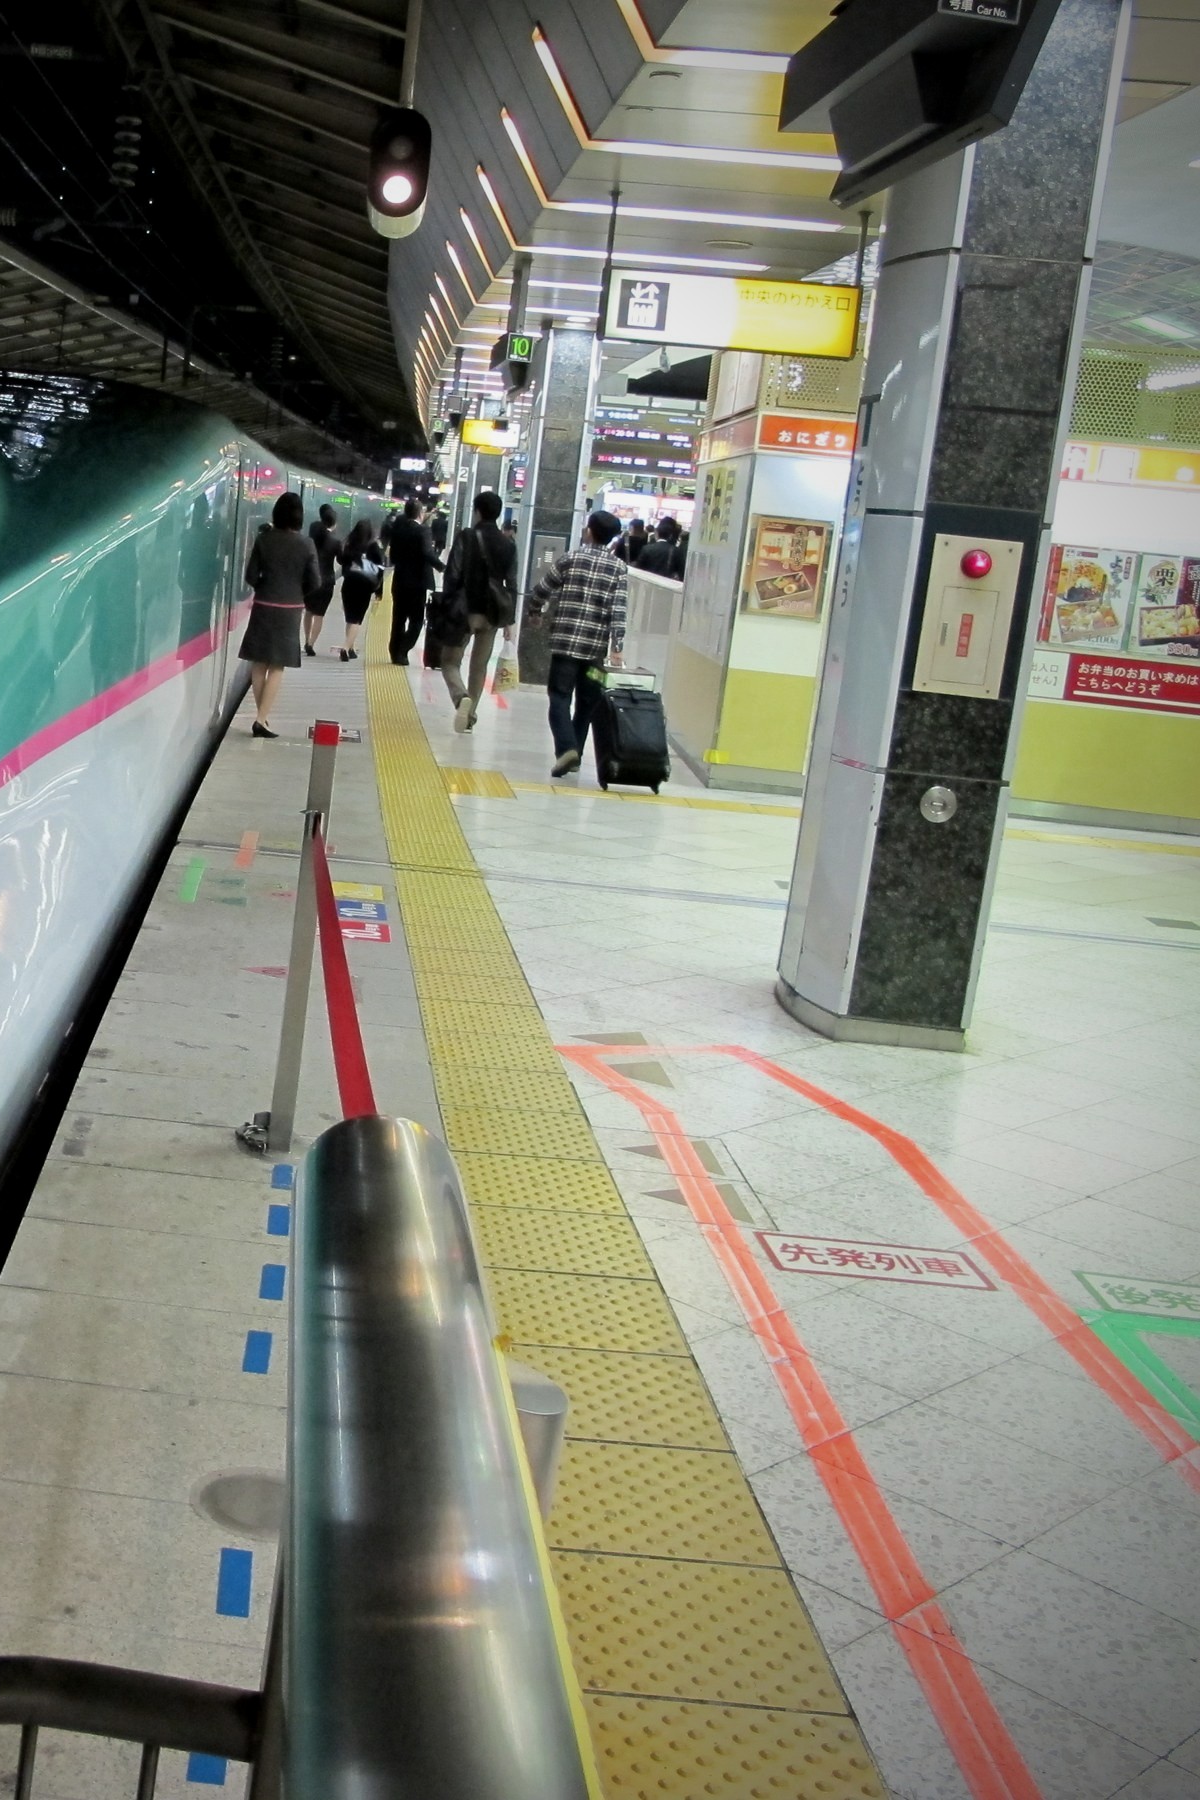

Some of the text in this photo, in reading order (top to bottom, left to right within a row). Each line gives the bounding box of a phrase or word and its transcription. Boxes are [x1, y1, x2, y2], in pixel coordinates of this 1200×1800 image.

[977, 5, 991, 16] Car
[992, 8, 1007, 18] No.
[740, 288, 851, 311] 中央のりかえ口
[512, 337, 530, 356] 10
[778, 430, 847, 448] おにぎり
[460, 467, 468, 479] 2
[1078, 662, 1200, 685] お弁当のお買い求めは
[1076, 676, 1161, 696] こちらへどうぞ
[780, 1243, 970, 1277] 先発列車
